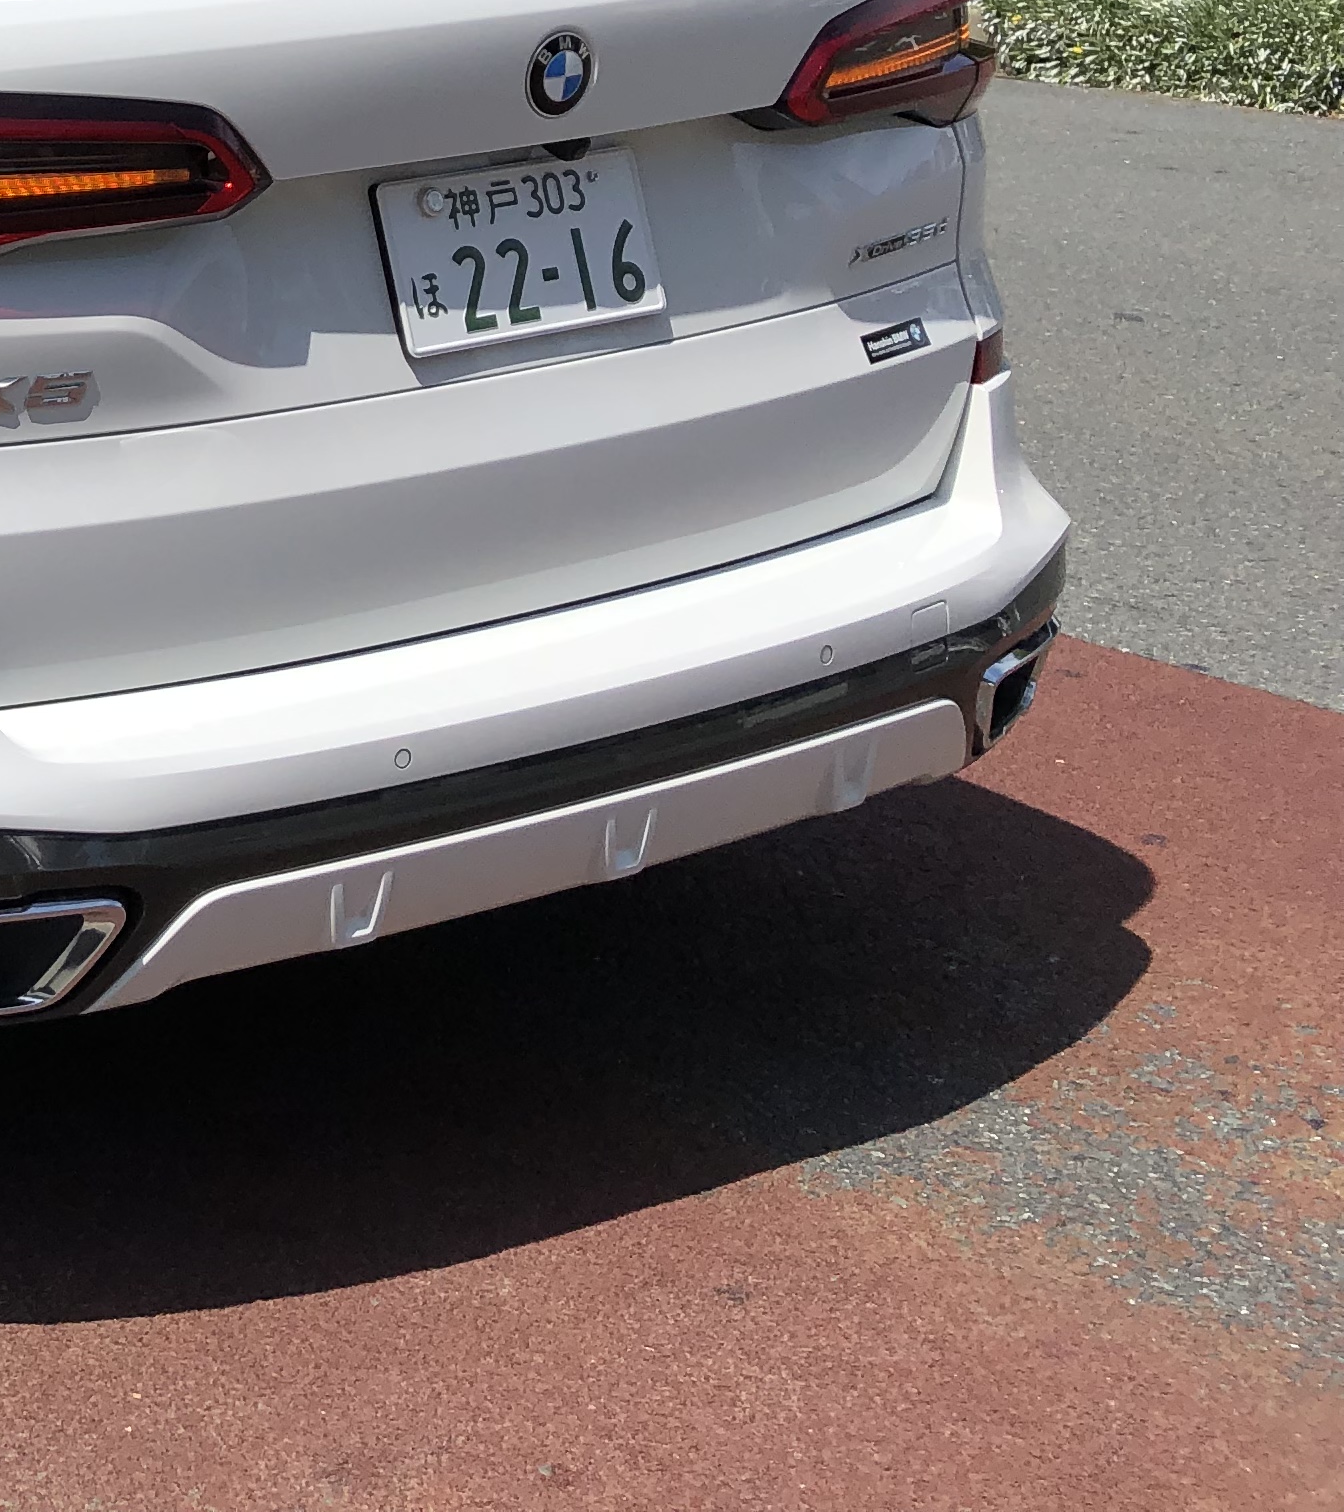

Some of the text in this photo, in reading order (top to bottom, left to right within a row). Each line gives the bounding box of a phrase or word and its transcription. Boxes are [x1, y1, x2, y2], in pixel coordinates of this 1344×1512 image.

[537, 35, 591, 66] BMW
[411, 273, 448, 319] ほ
[452, 219, 646, 333] 22-16
